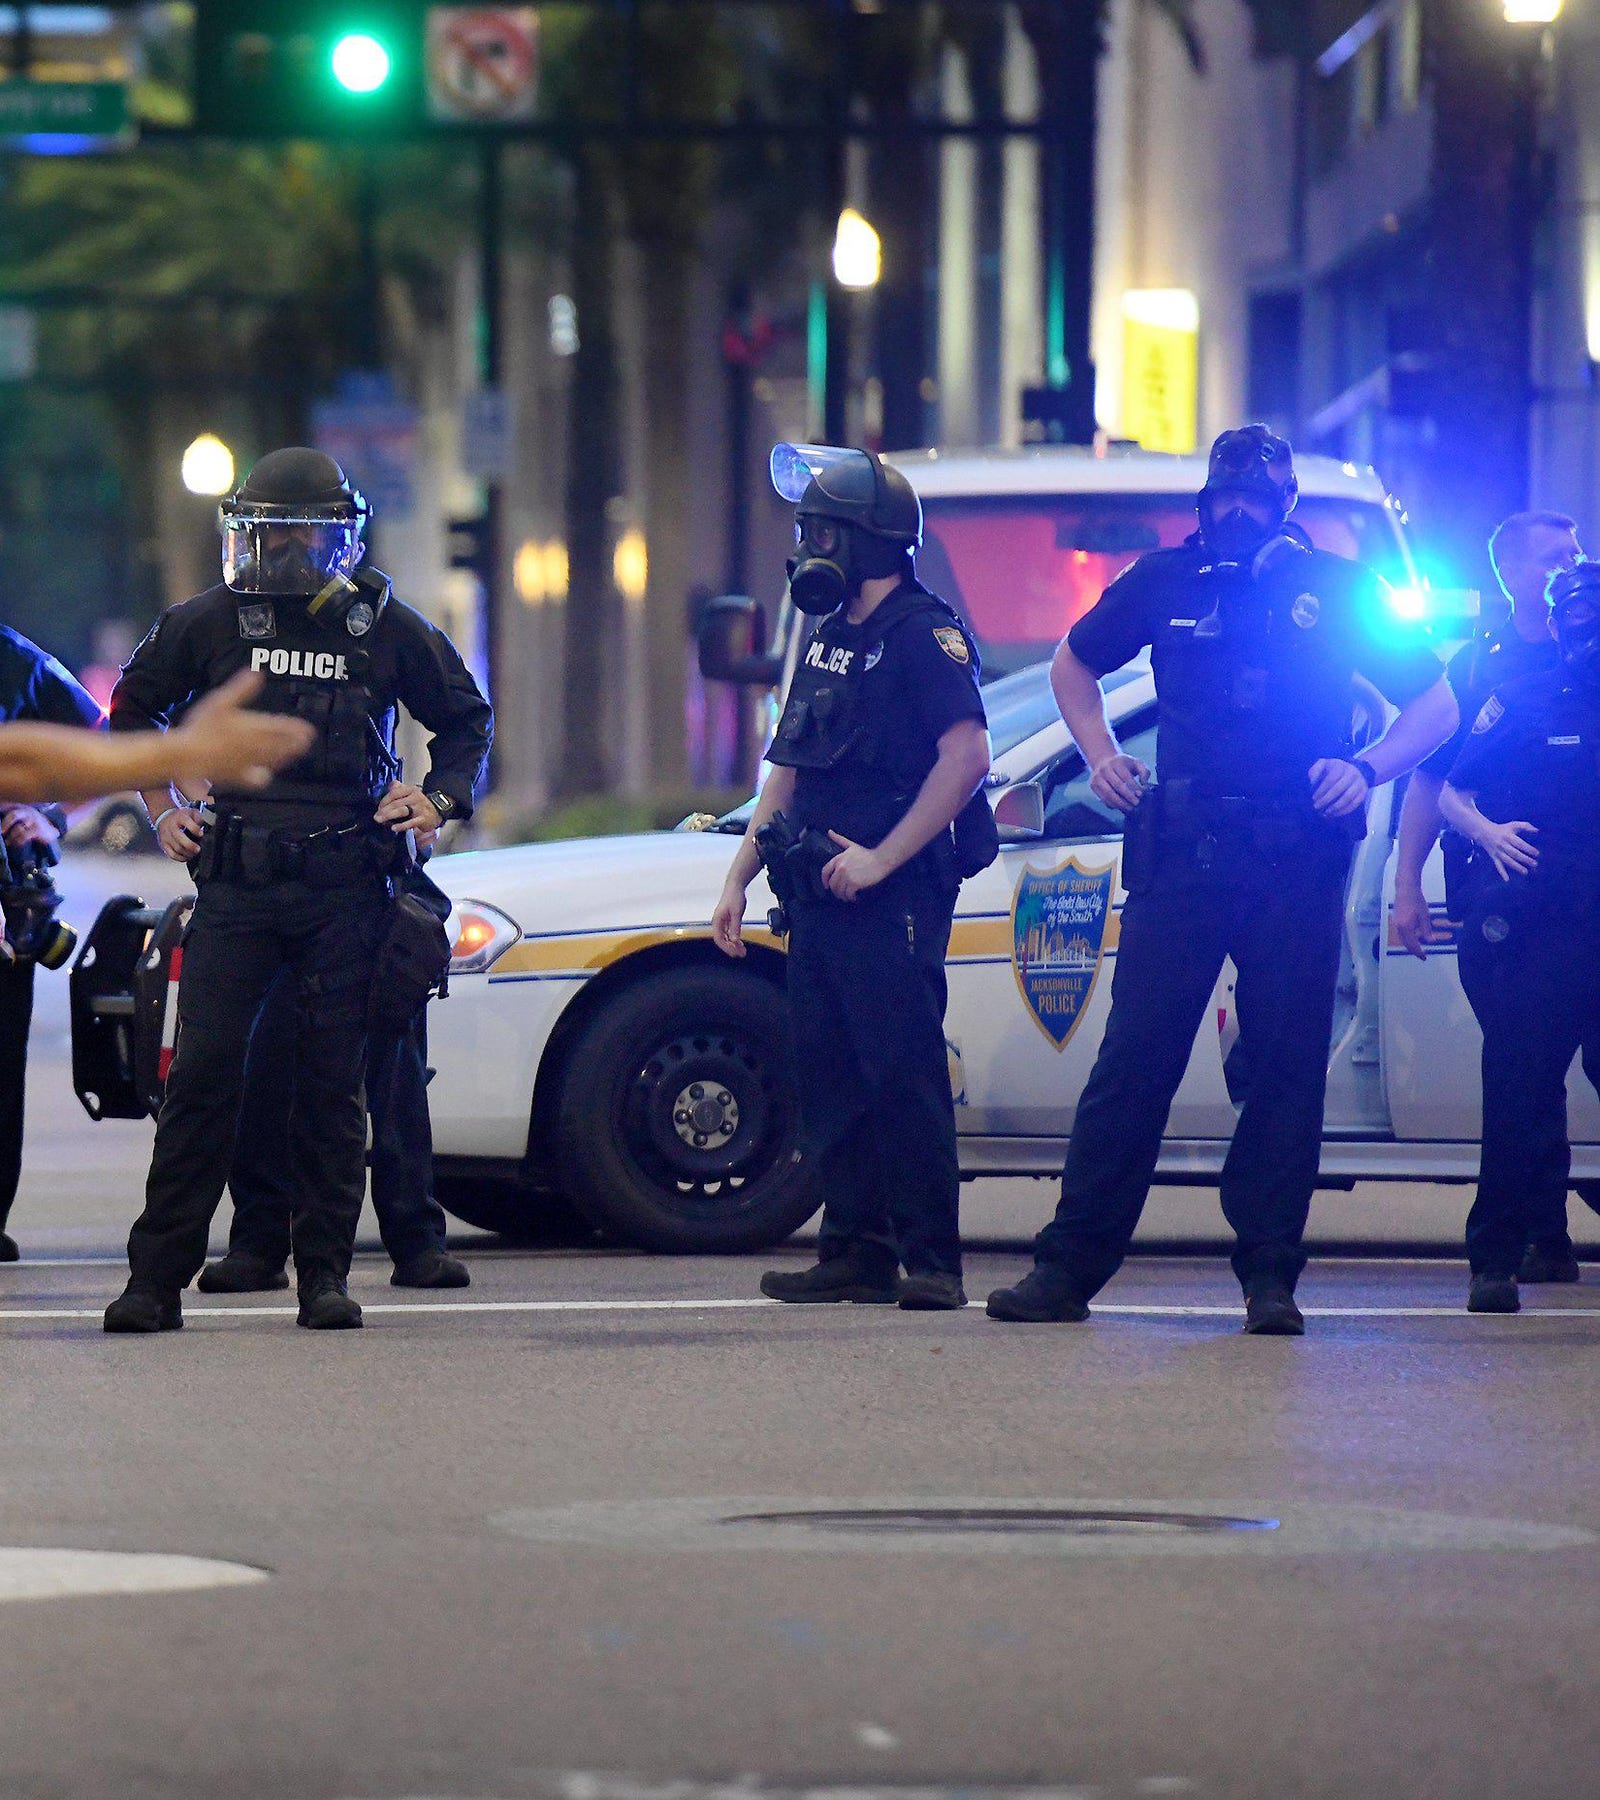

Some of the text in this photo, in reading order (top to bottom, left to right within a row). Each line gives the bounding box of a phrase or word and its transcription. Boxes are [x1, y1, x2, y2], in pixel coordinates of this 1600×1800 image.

[250, 647, 349, 681] POLICE
[804, 641, 855, 676] POICE
[1058, 880, 1067, 895] OF
[1031, 978, 1083, 992] JACKSONVILLE
[1038, 993, 1076, 1014] POLICE
